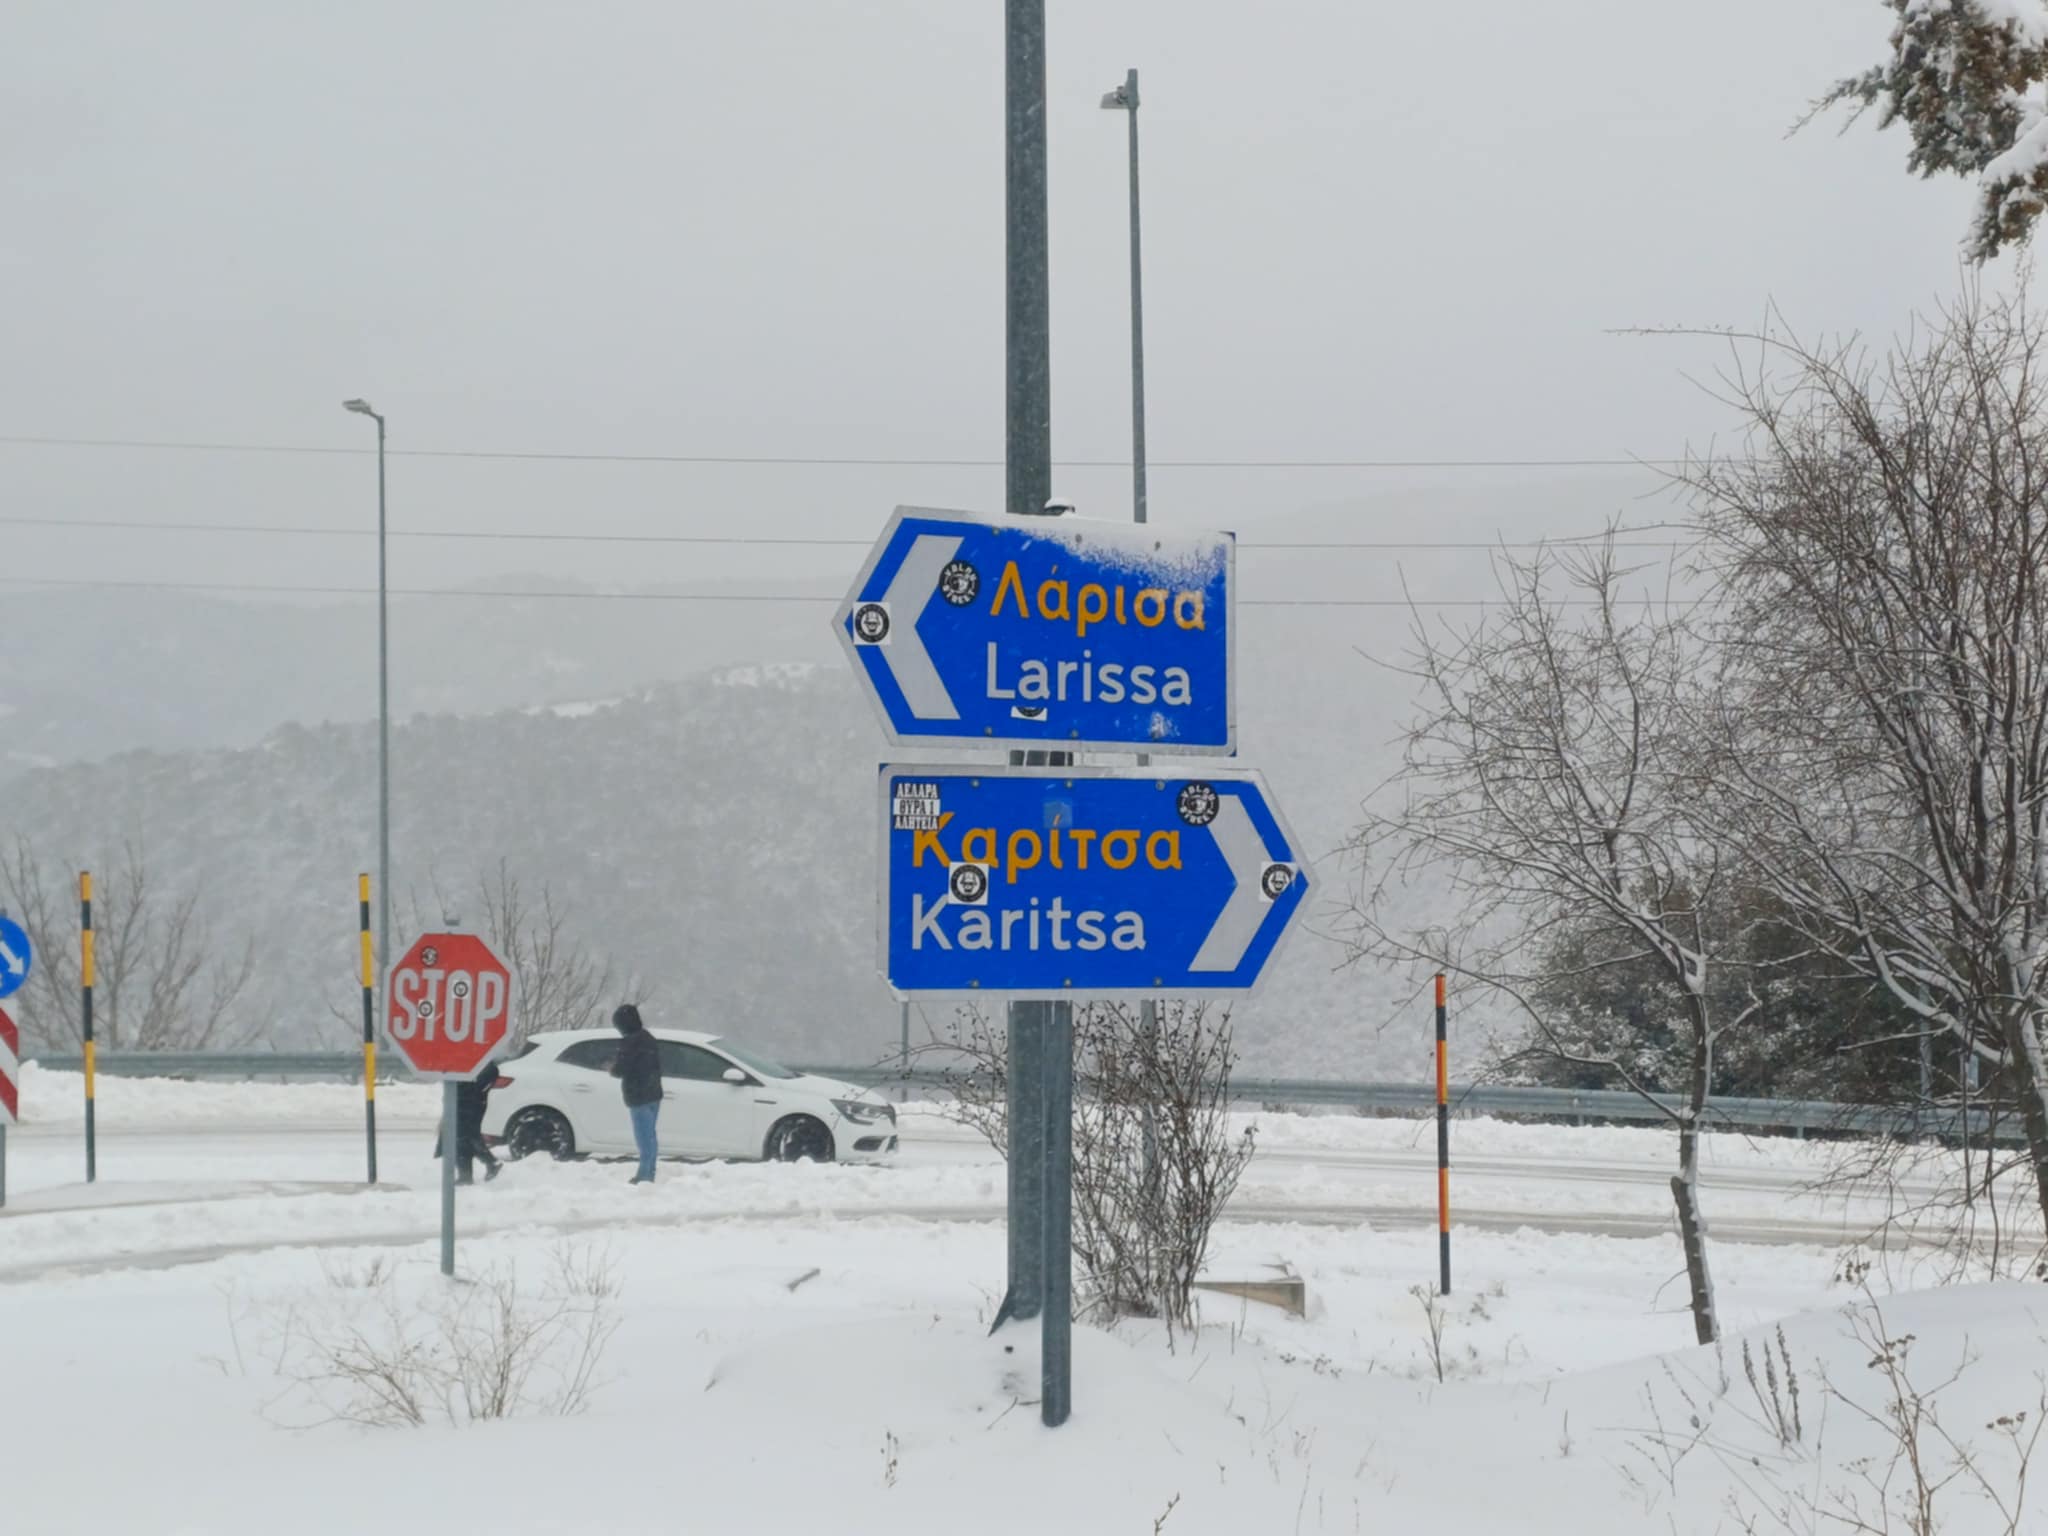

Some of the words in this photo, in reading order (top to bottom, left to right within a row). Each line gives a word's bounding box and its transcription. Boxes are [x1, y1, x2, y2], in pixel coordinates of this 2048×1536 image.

[990, 560, 1206, 637] Λάρισα
[986, 641, 1193, 706] Larissa
[912, 812, 1183, 884] Καρίτσα
[911, 893, 1147, 951] Karitsa
[393, 969, 504, 1044] STOP
